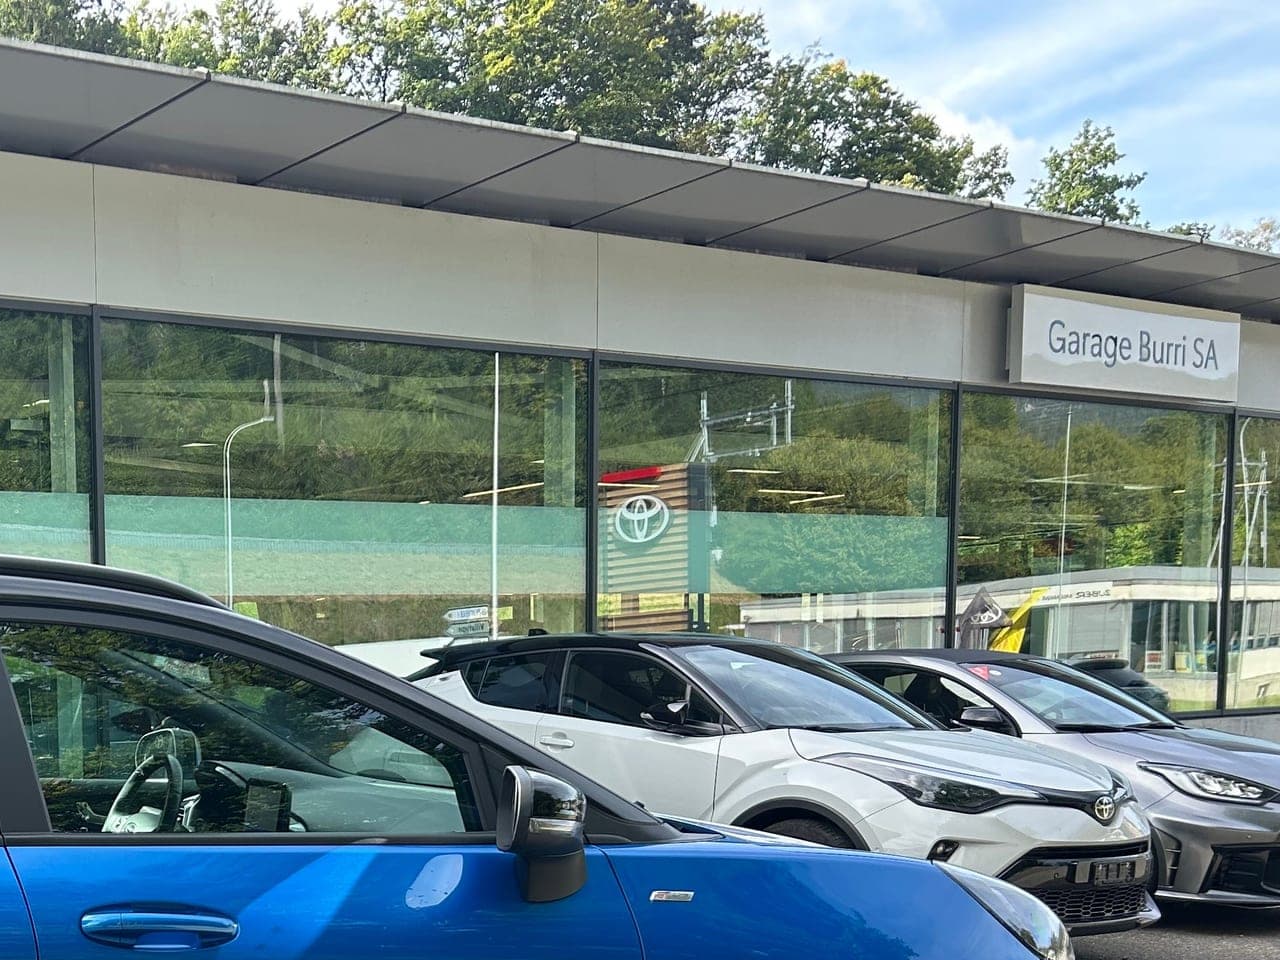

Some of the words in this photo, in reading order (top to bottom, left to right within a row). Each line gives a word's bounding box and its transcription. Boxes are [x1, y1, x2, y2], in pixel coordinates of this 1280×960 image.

[1048, 319, 1132, 368] Garage
[1138, 330, 1187, 367] Burri
[1192, 337, 1219, 370] SA
